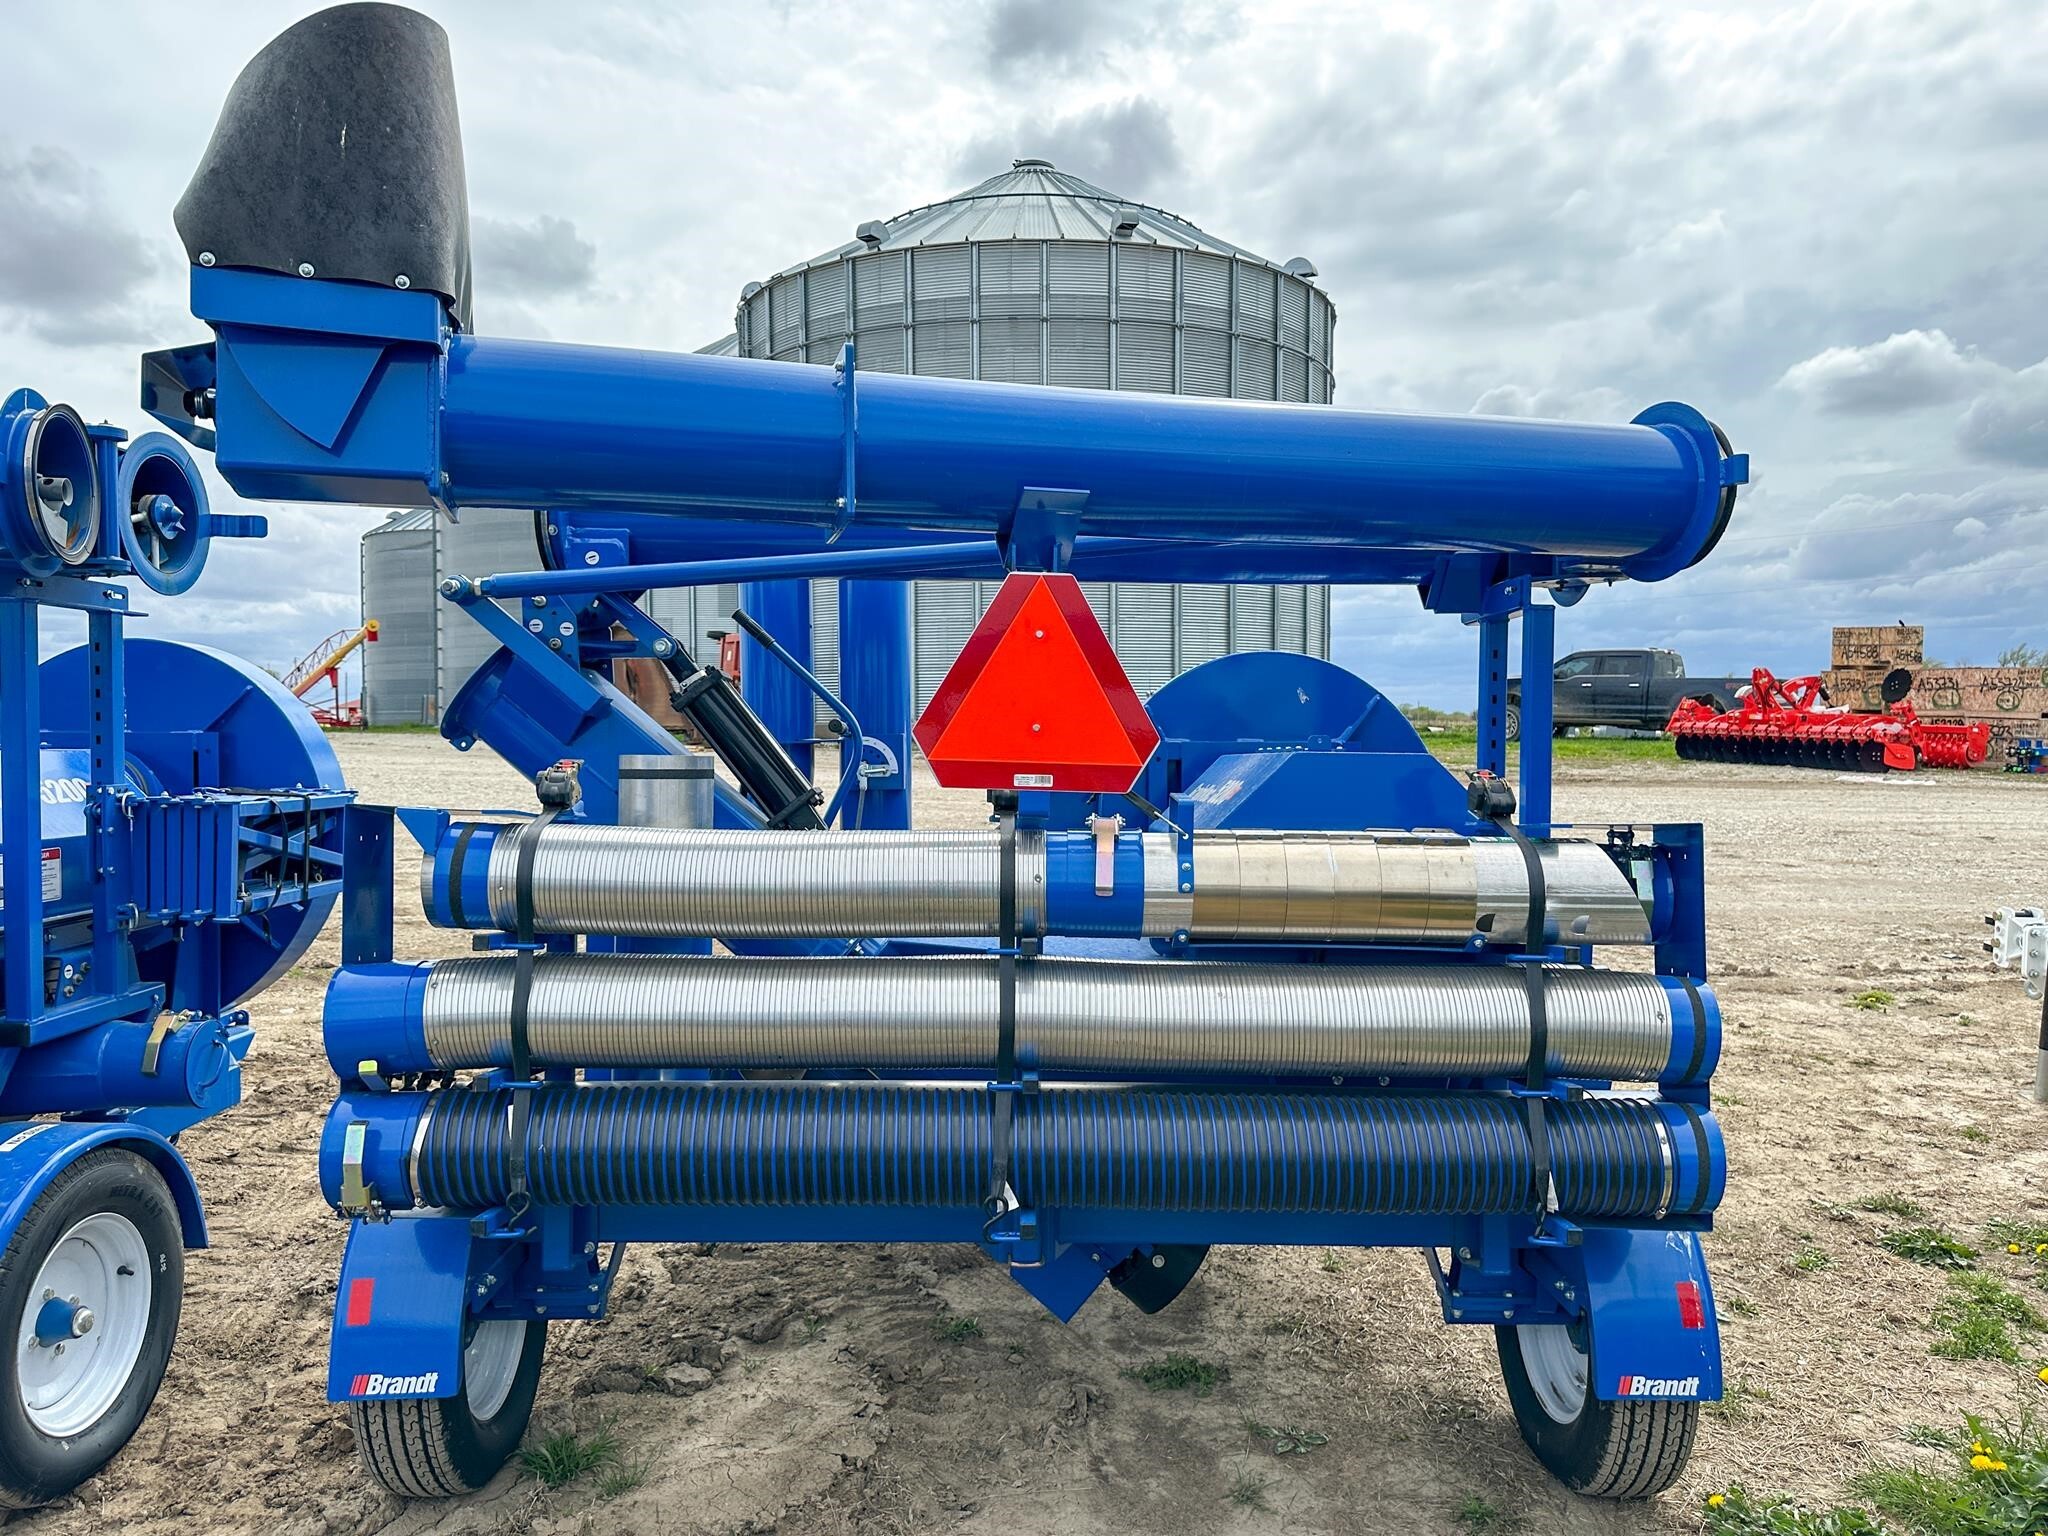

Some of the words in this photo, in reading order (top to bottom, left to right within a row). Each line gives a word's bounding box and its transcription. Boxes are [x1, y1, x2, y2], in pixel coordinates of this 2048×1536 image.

[1918, 676, 1959, 692] A53731
[365, 1372, 439, 1396] Brandt
[1629, 1375, 1699, 1396] Brandt
